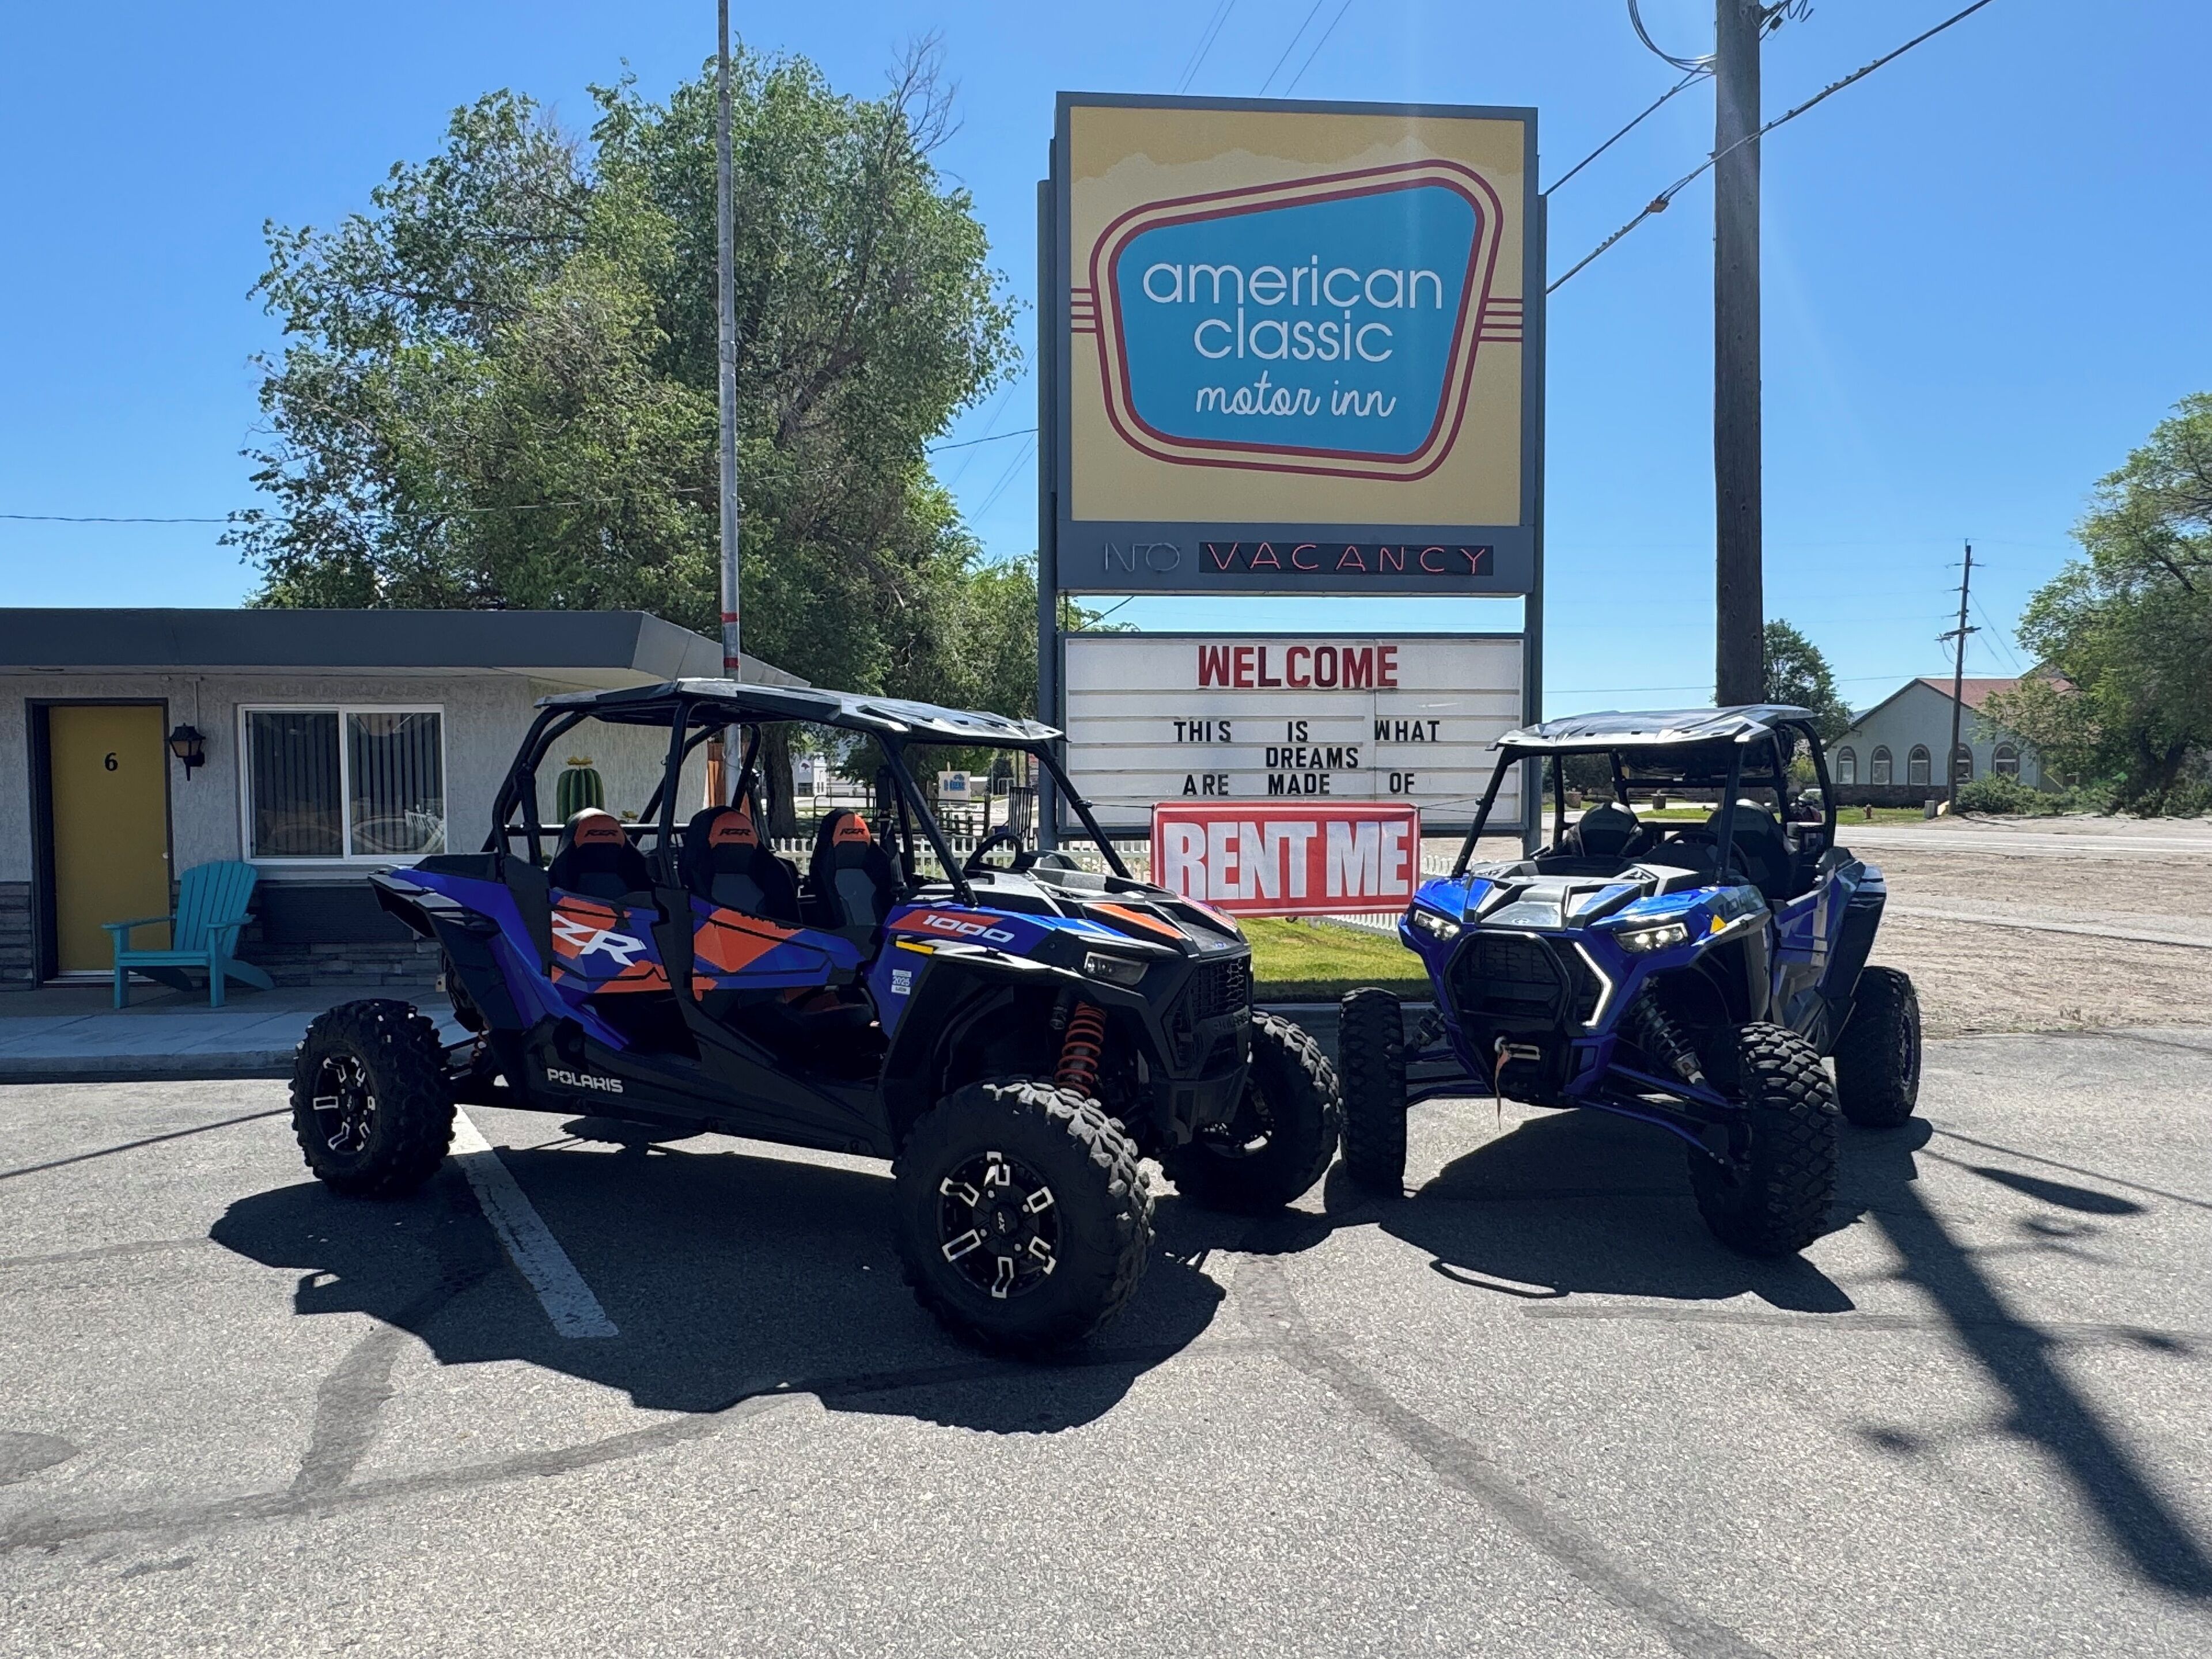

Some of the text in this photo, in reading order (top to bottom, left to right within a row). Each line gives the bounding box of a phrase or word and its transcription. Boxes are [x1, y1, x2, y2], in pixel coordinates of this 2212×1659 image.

[1142, 255, 1442, 309] american
[1194, 307, 1393, 362] classic
[1195, 370, 1396, 418] motor inn
[1104, 542, 1486, 575] NO VACANCY
[1198, 645, 1398, 688] WELCOME
[1173, 720, 1440, 743] THIS IS WHAT
[104, 752, 119, 771] 6
[1266, 747, 1359, 769] DREAMS
[1183, 772, 1415, 796] ARE MADE OF
[1163, 820, 1409, 900] RENT ME
[922, 914, 1015, 943] 1000
[547, 1067, 623, 1093] POLARIS
